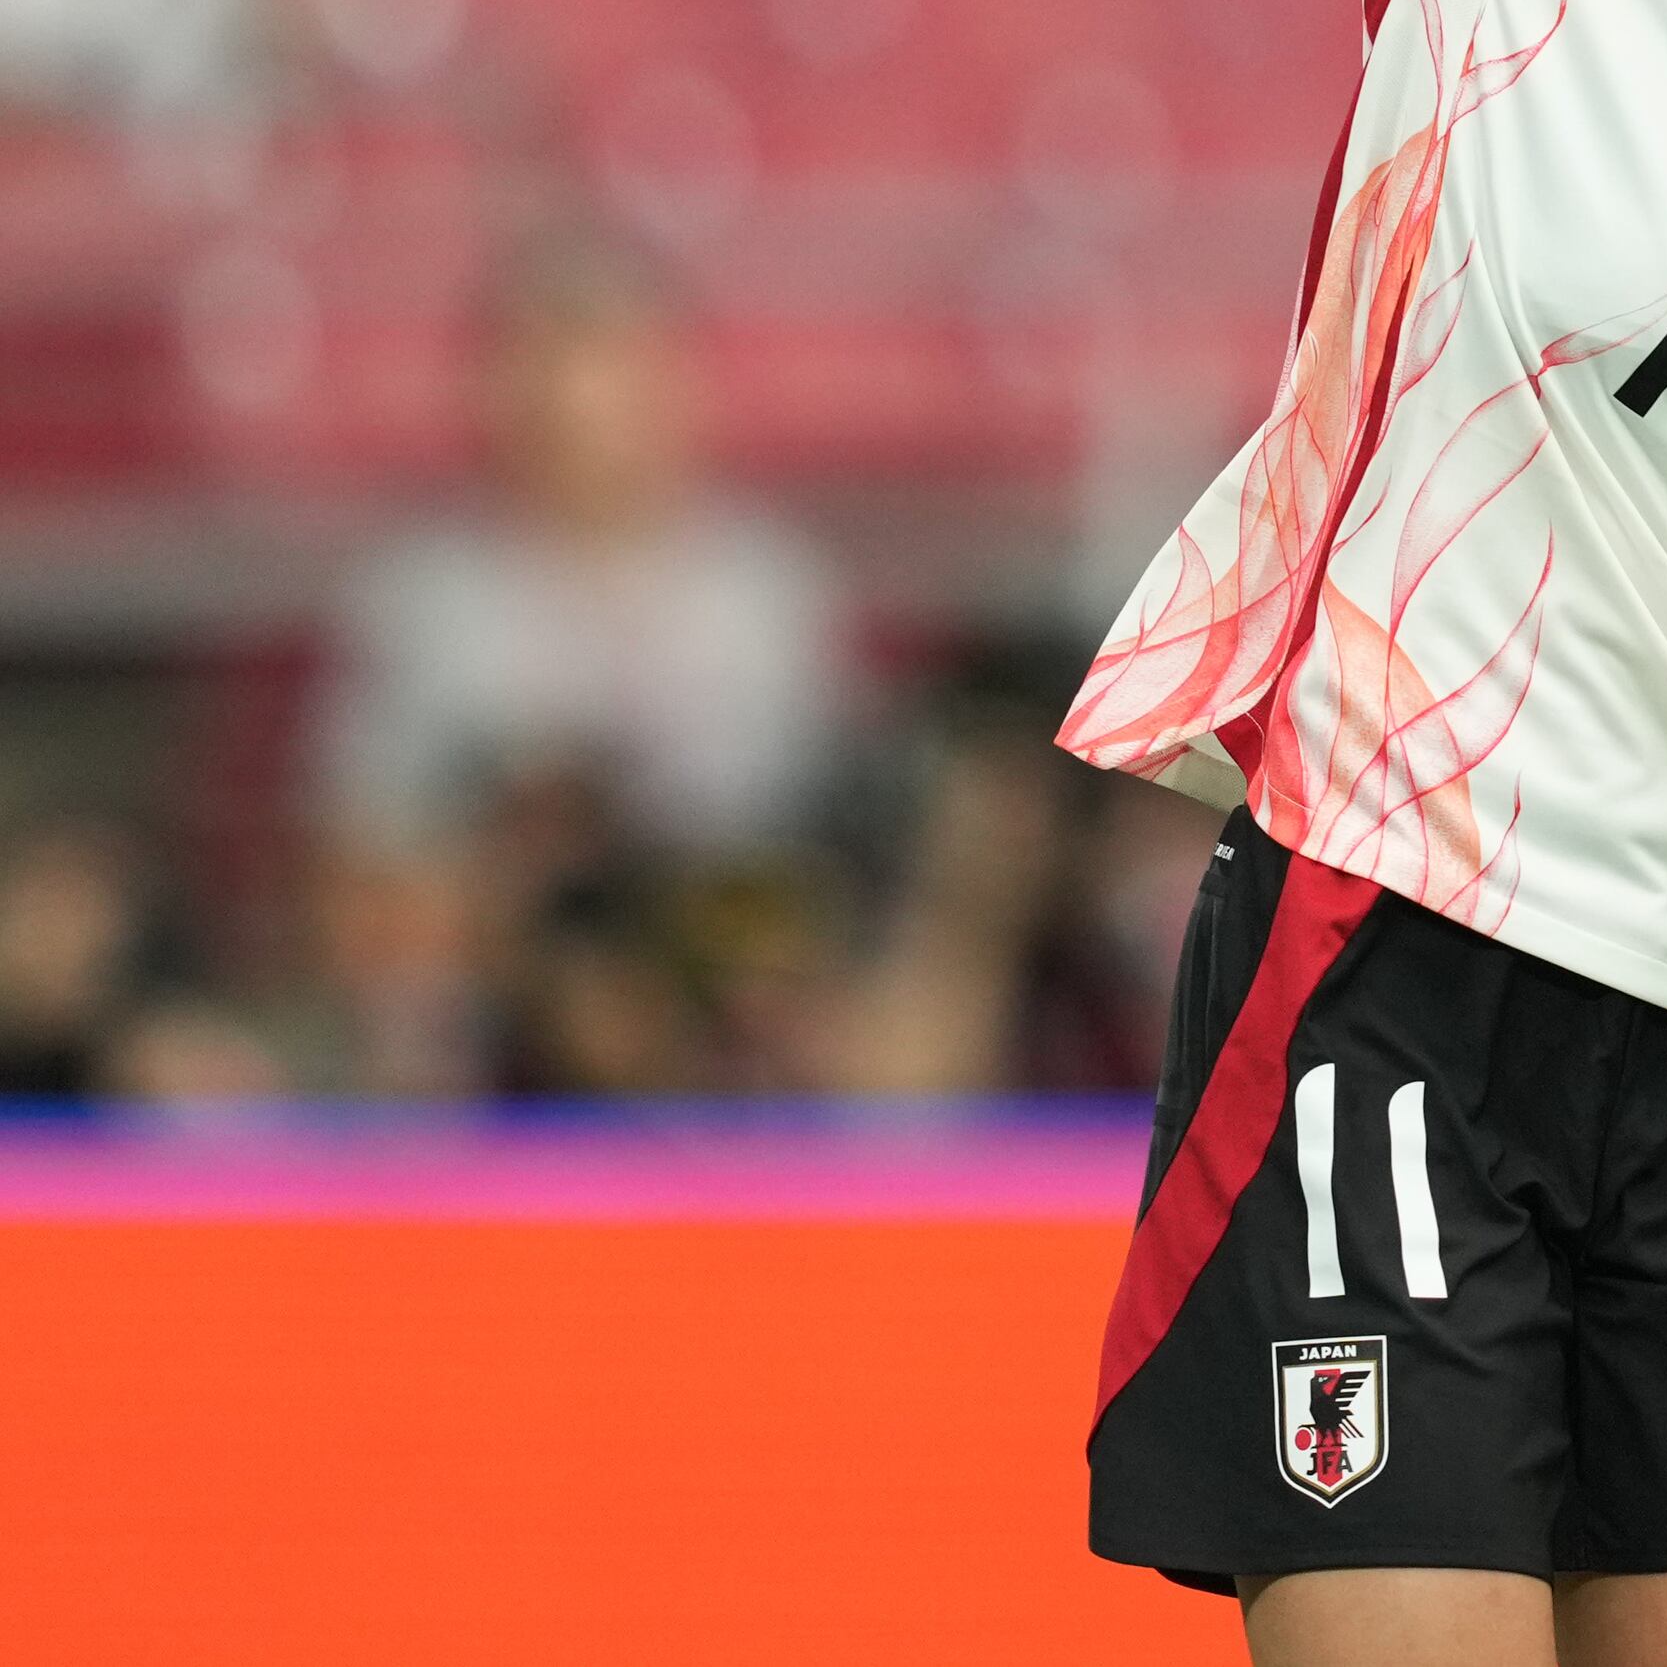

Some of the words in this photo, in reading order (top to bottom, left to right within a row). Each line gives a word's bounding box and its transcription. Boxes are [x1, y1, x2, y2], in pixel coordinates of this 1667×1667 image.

[1294, 1062, 1449, 1300] 11
[1298, 1344, 1358, 1361] JAPAN
[1306, 1450, 1355, 1477] JFA
